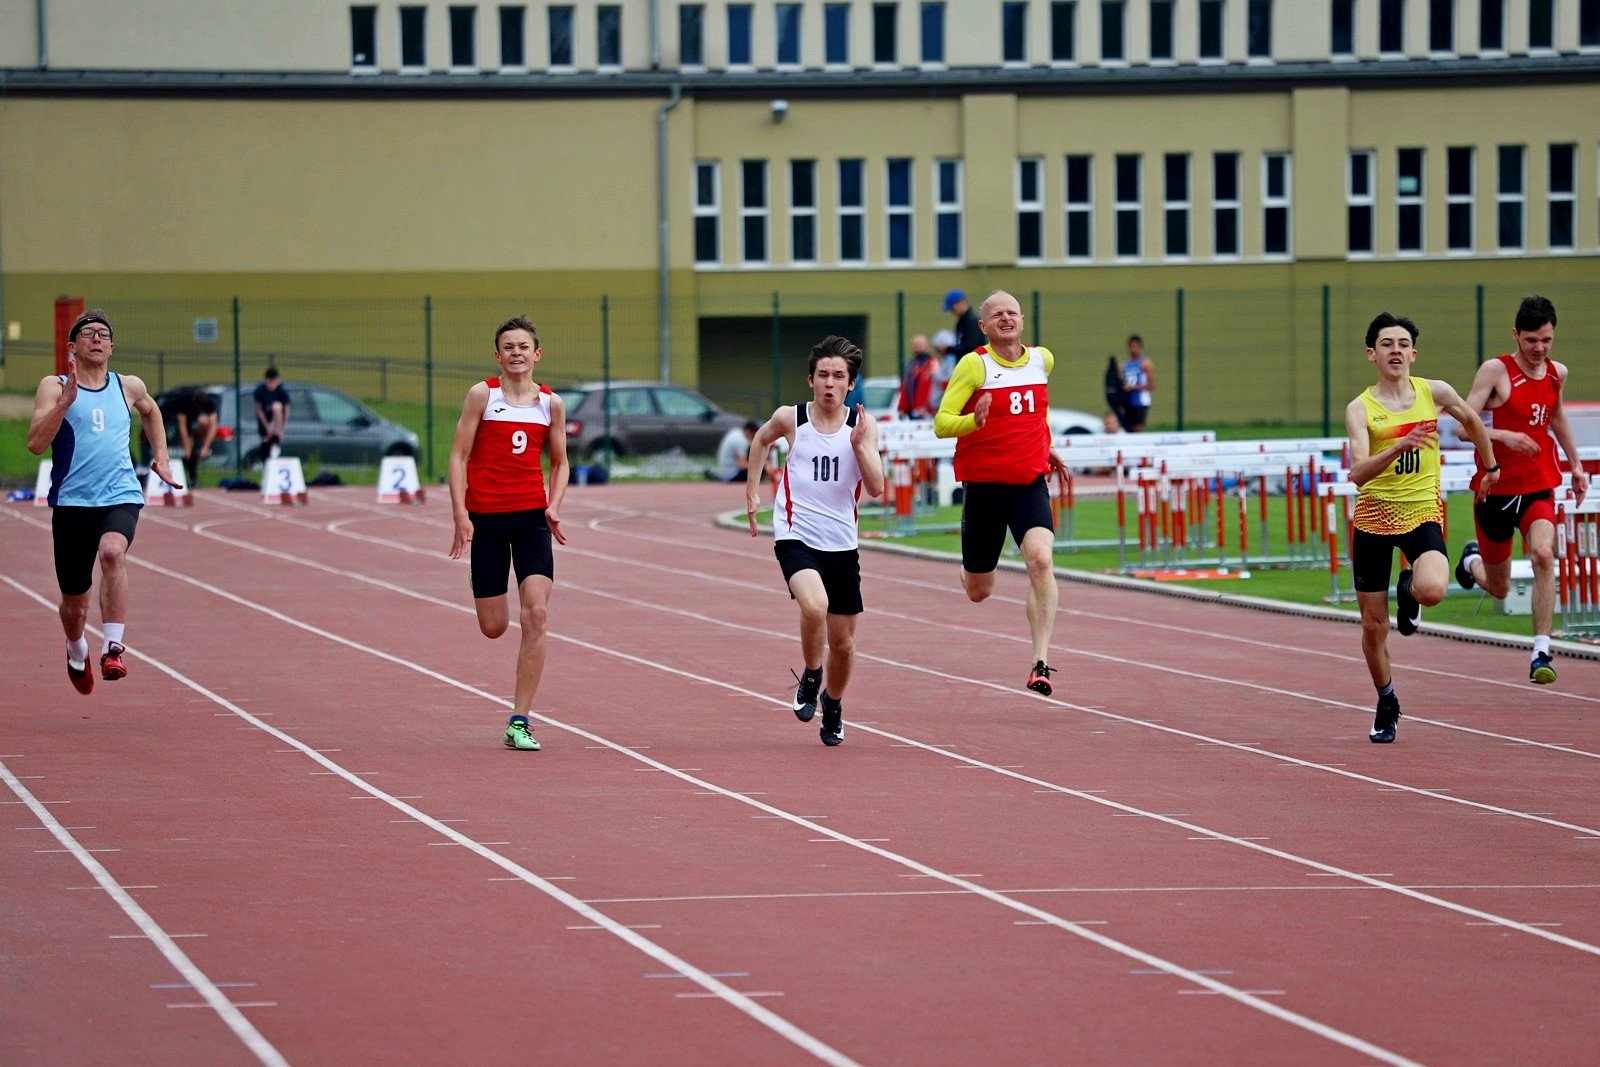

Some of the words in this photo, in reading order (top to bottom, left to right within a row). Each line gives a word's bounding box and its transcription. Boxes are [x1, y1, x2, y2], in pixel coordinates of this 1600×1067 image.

[1009, 390, 1035, 415] 81
[92, 408, 105, 432] 9
[512, 430, 528, 455] 9
[812, 455, 839, 481] 101
[1394, 448, 1420, 475] 301
[278, 468, 292, 492] 3
[391, 467, 407, 491] 2
